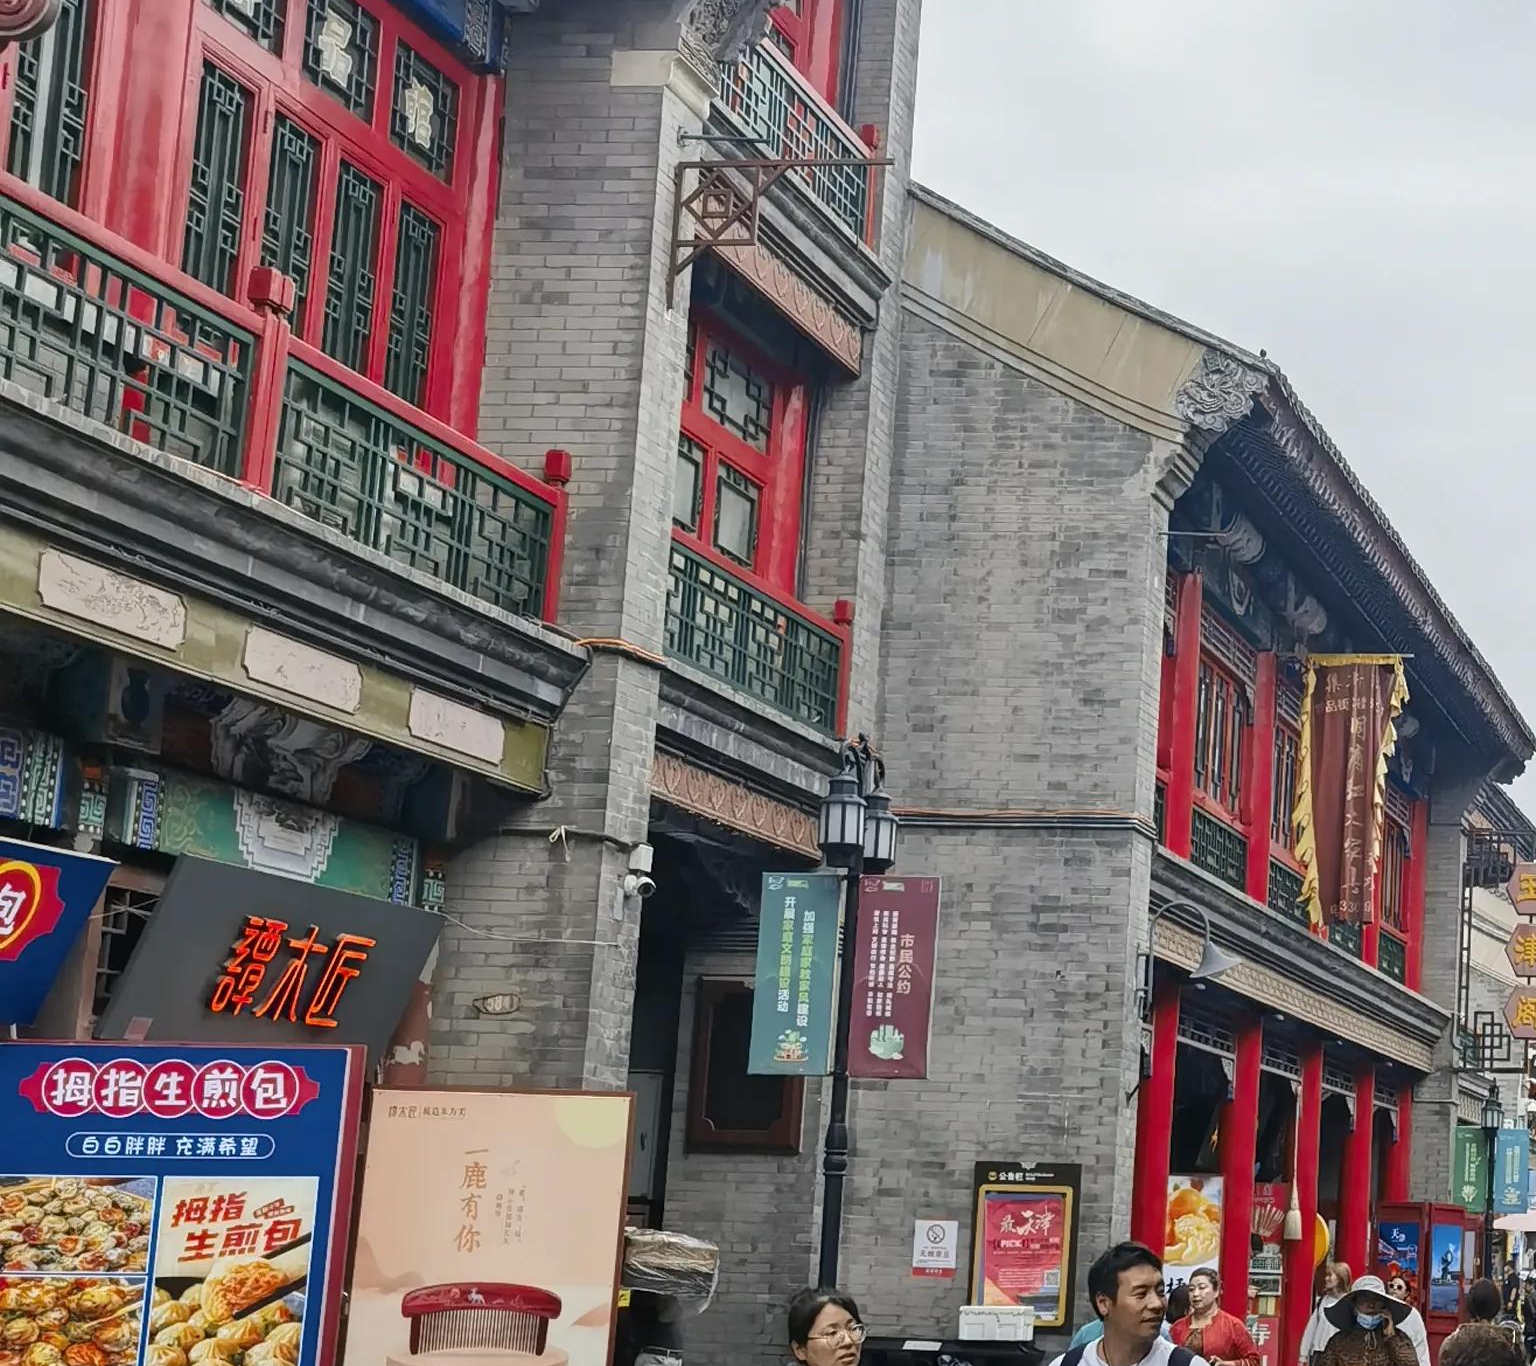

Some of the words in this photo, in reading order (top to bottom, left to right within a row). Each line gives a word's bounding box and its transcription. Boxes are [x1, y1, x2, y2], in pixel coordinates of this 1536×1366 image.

[896, 933, 915, 994] 市民公约
[51, 1067, 287, 1109] 拇指生煎包
[176, 1137, 259, 1157] 充满希望
[170, 1191, 248, 1228] 拇指
[454, 1148, 489, 1253] 一鹿有你
[176, 1218, 303, 1263] 生煎包
